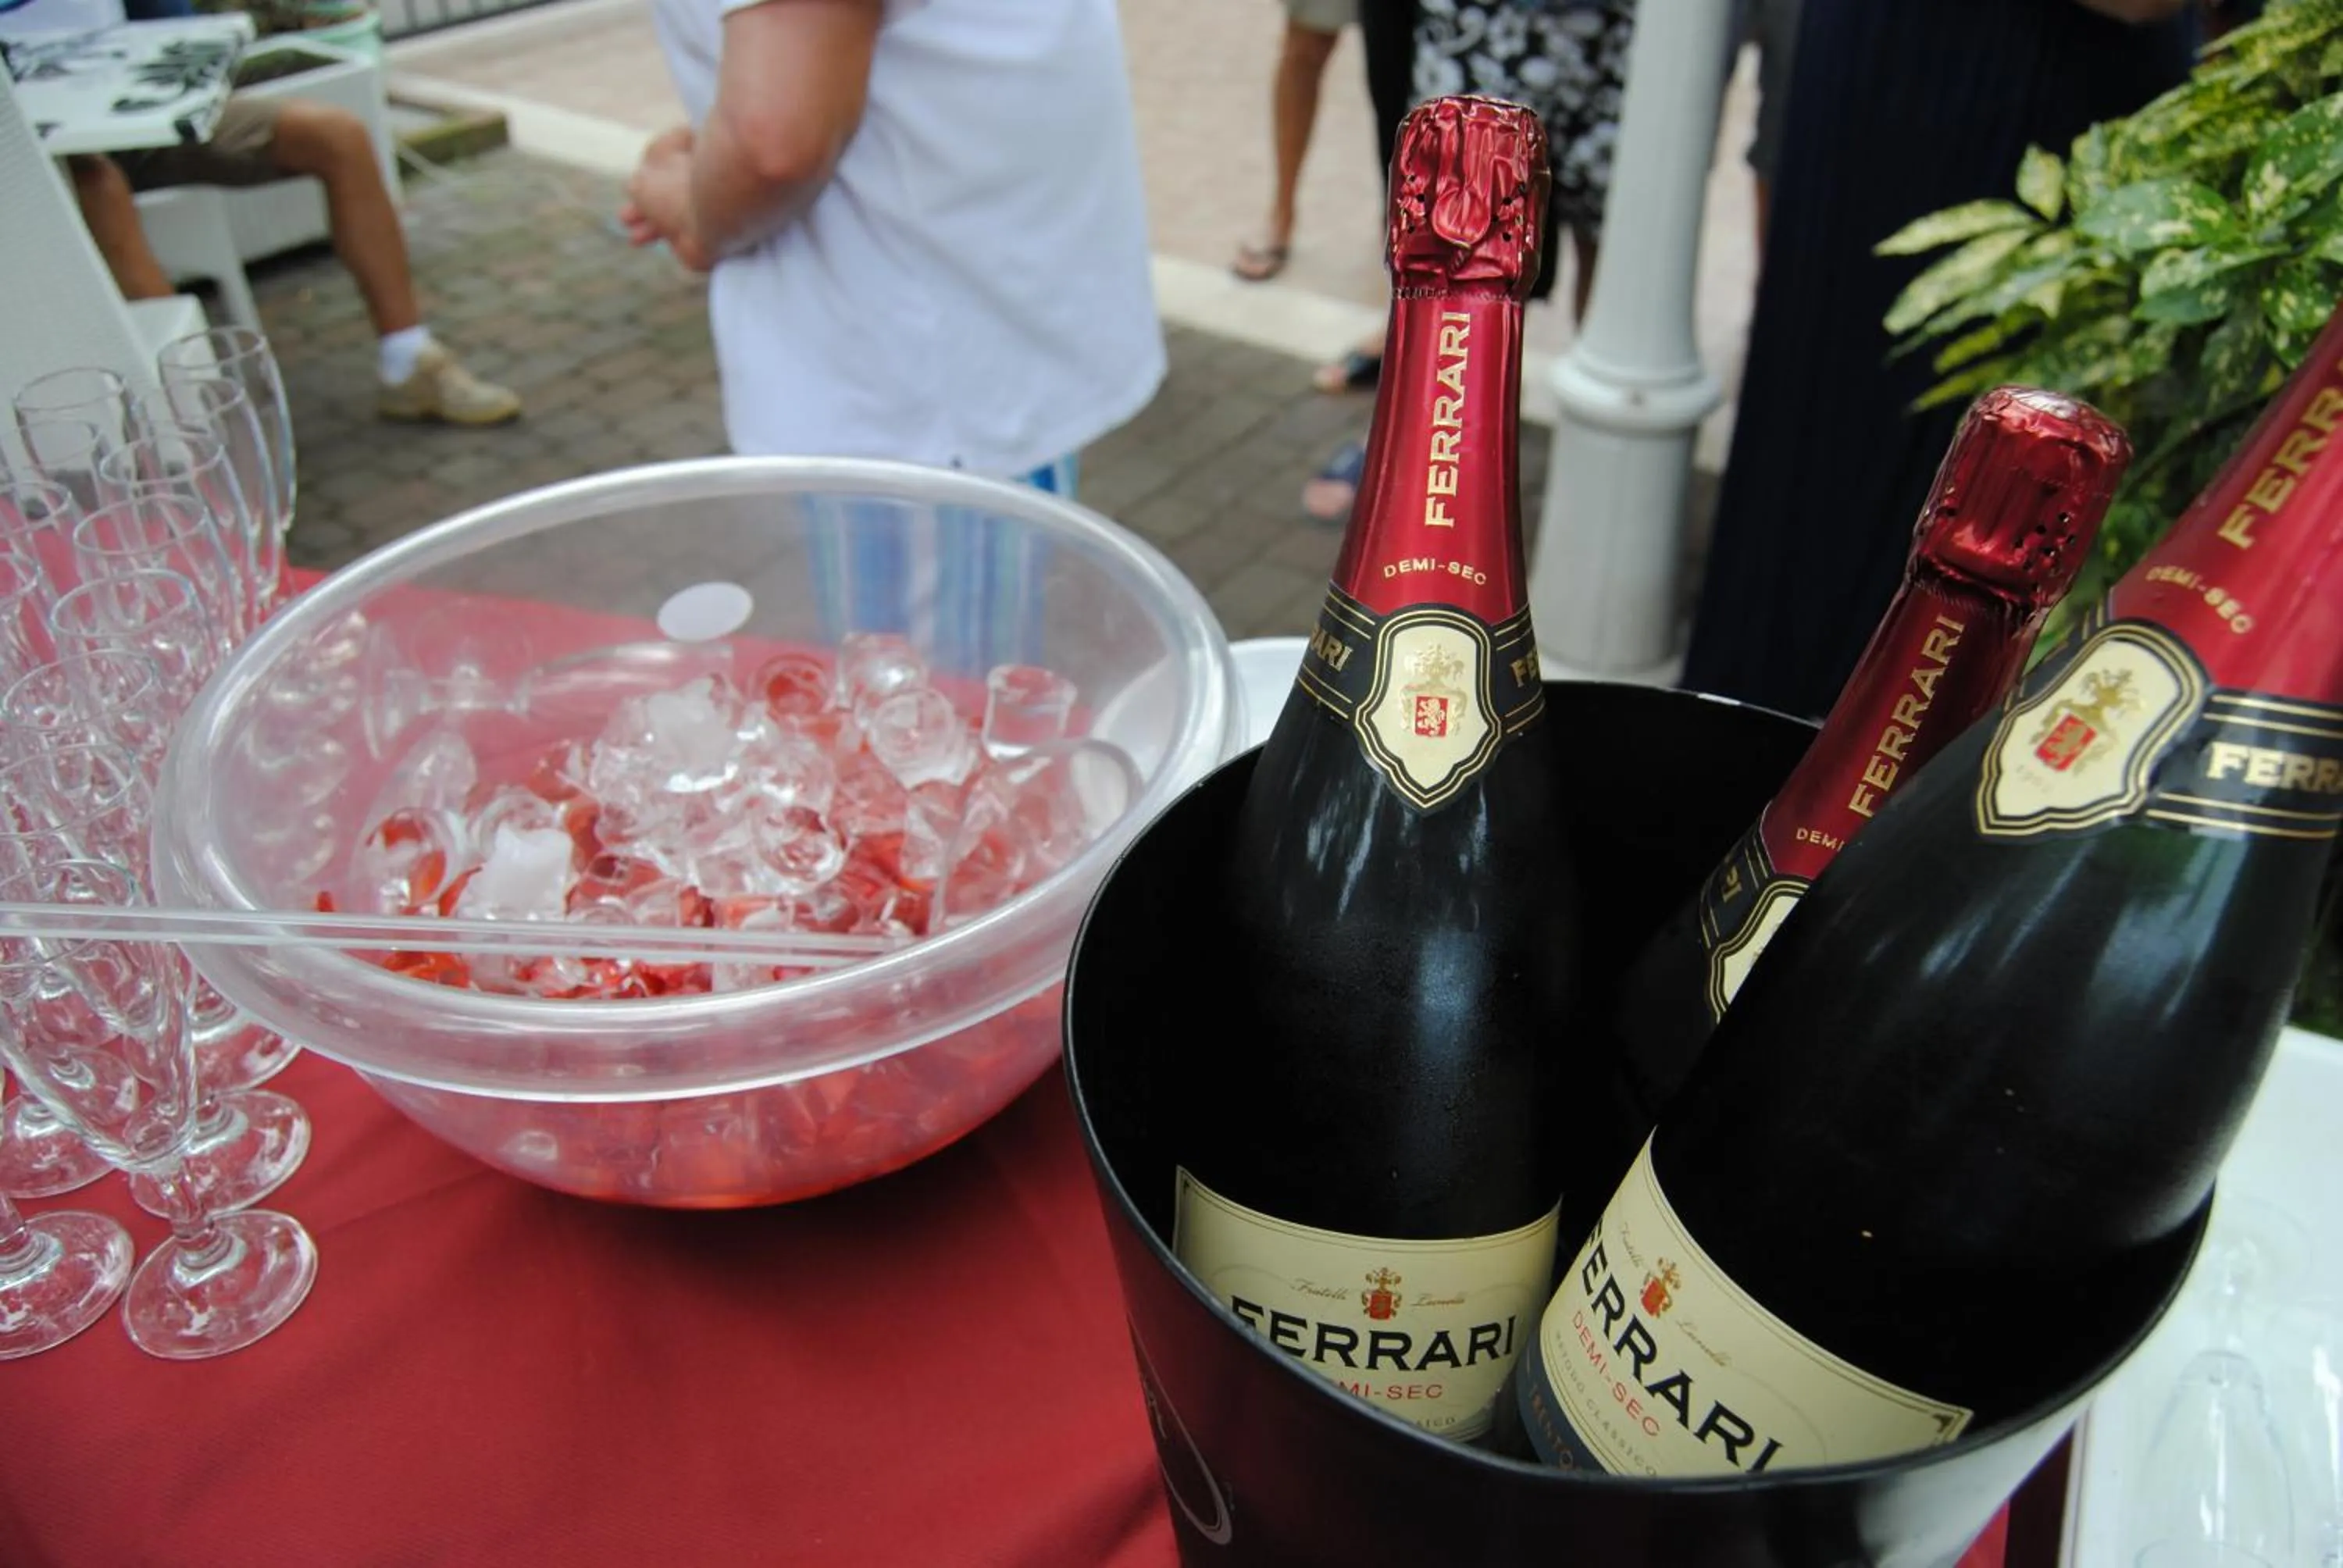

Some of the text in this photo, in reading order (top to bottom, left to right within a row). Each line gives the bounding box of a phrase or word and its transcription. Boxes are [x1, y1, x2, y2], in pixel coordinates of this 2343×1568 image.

[1425, 311, 1471, 528] FERRARI
[2216, 383, 2343, 549] FERR
[1383, 558, 1487, 586] DEMI-SEC
[1847, 614, 1965, 818] FERRARI
[2206, 741, 2343, 795] FERR
[1796, 827, 1846, 853] DEMI
[1339, 1380, 1444, 1401] MI-SEC
[1572, 1310, 1661, 1438] DEMI-SEC
